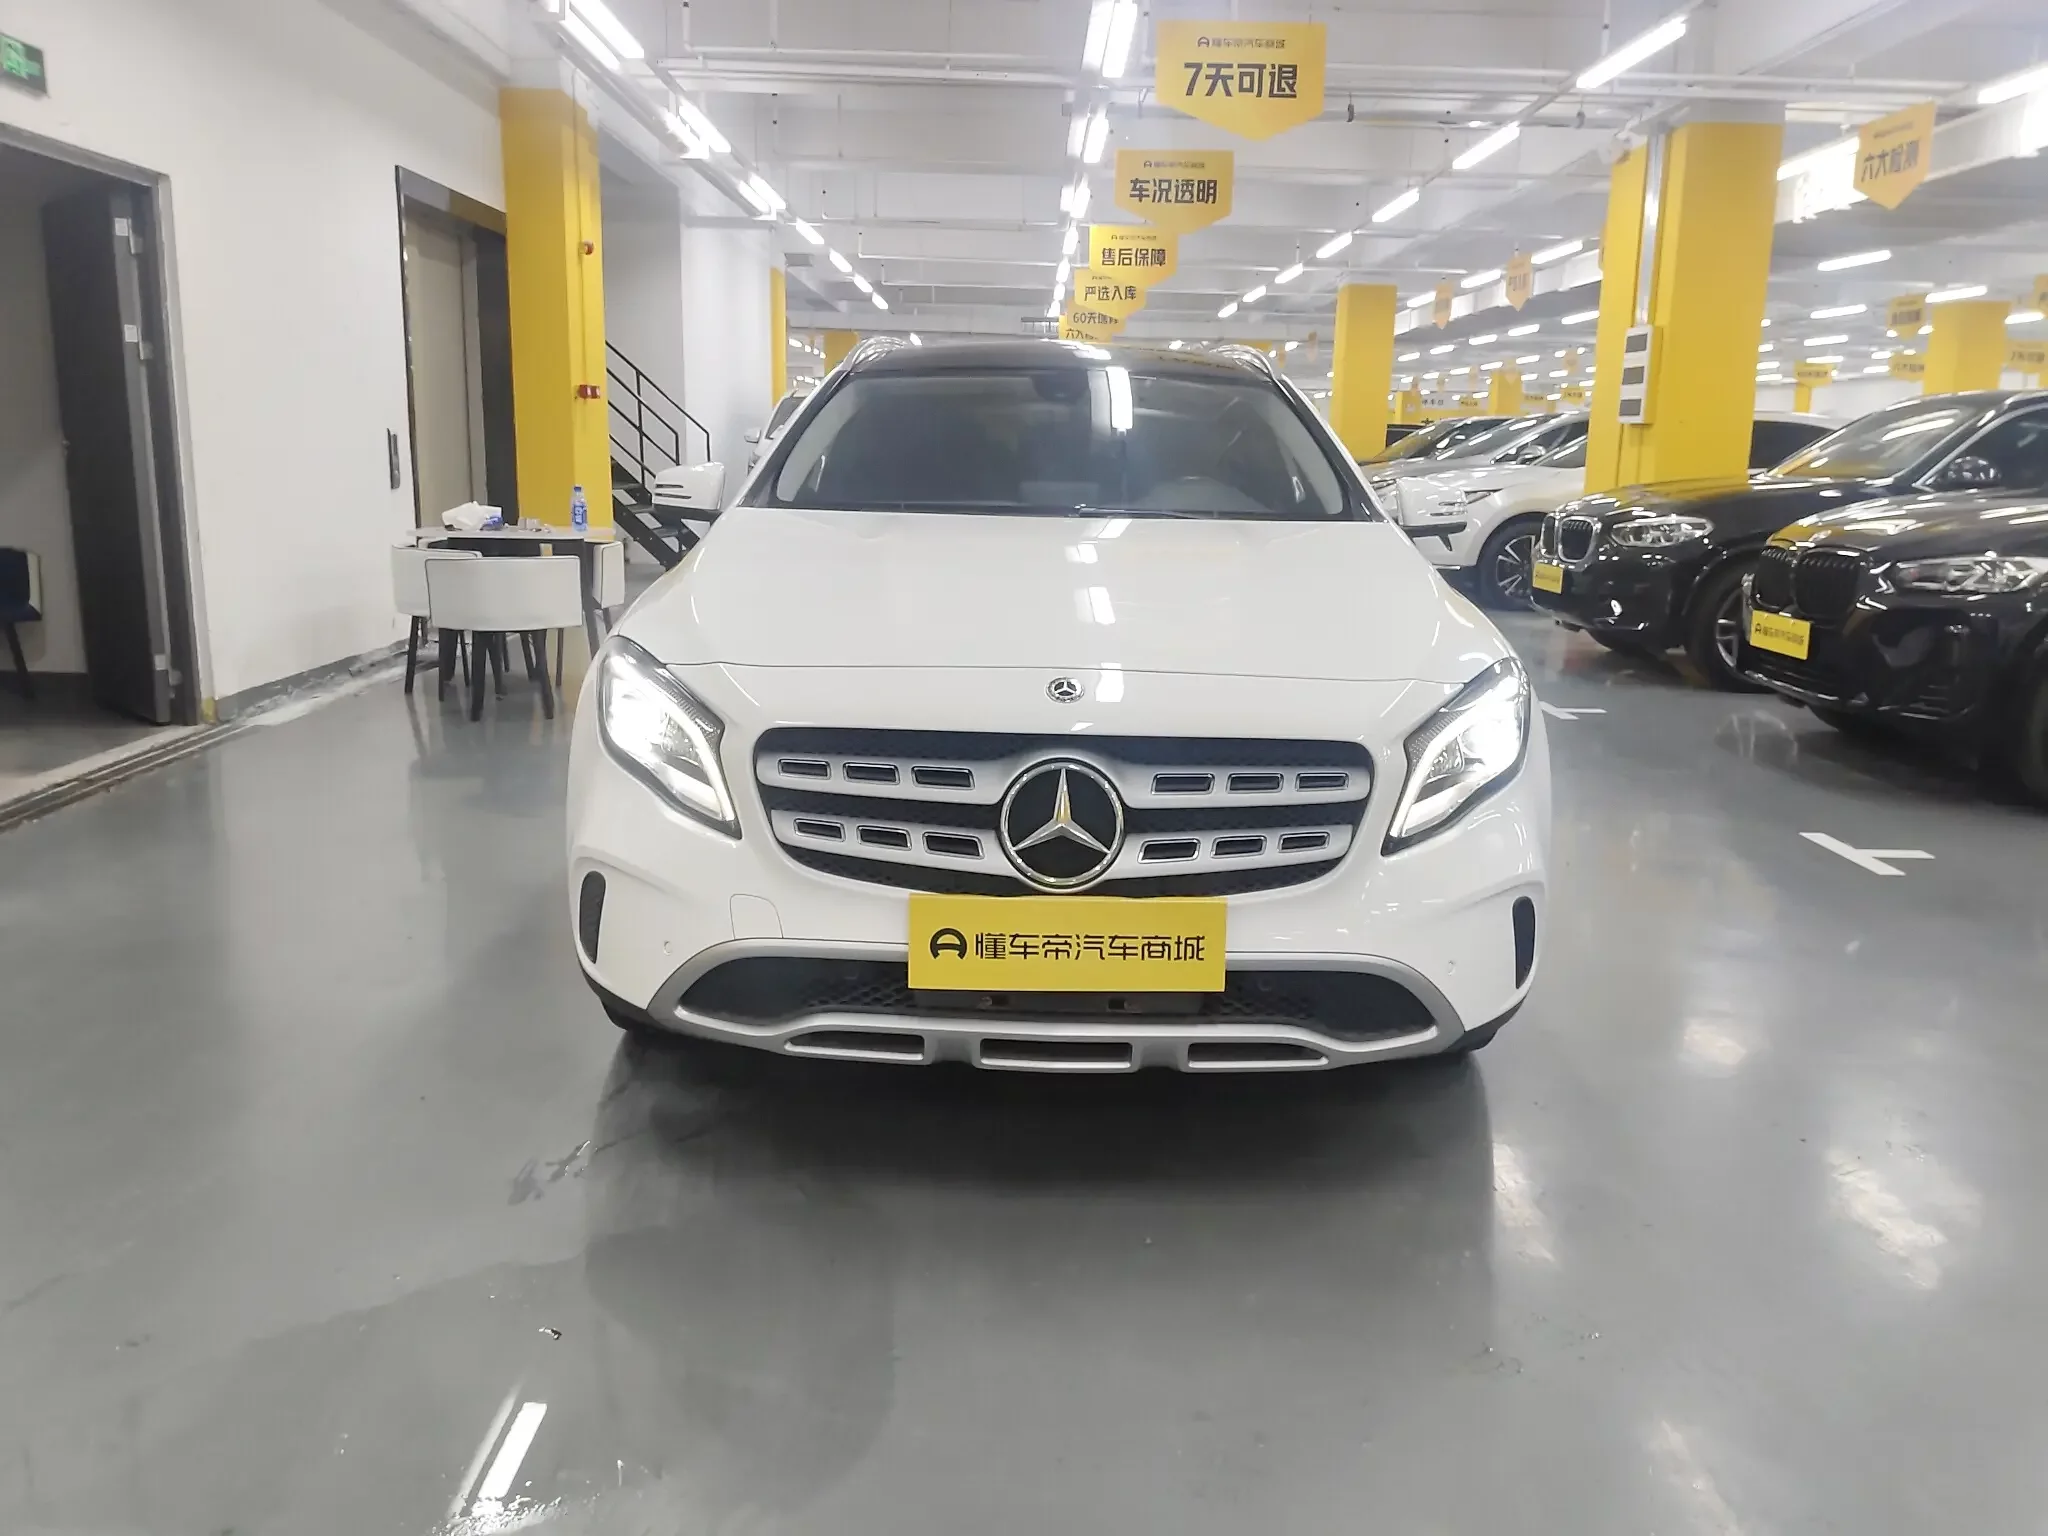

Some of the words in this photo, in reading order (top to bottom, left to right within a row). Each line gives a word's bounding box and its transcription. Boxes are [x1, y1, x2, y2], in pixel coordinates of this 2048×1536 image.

[1183, 62, 1298, 98] 7天可退
[1129, 178, 1218, 204] 车况透明
[1102, 248, 1166, 266] 售后保障
[1084, 286, 1137, 301] 严选入库
[975, 932, 1205, 961] 懂车帝汽车商城
